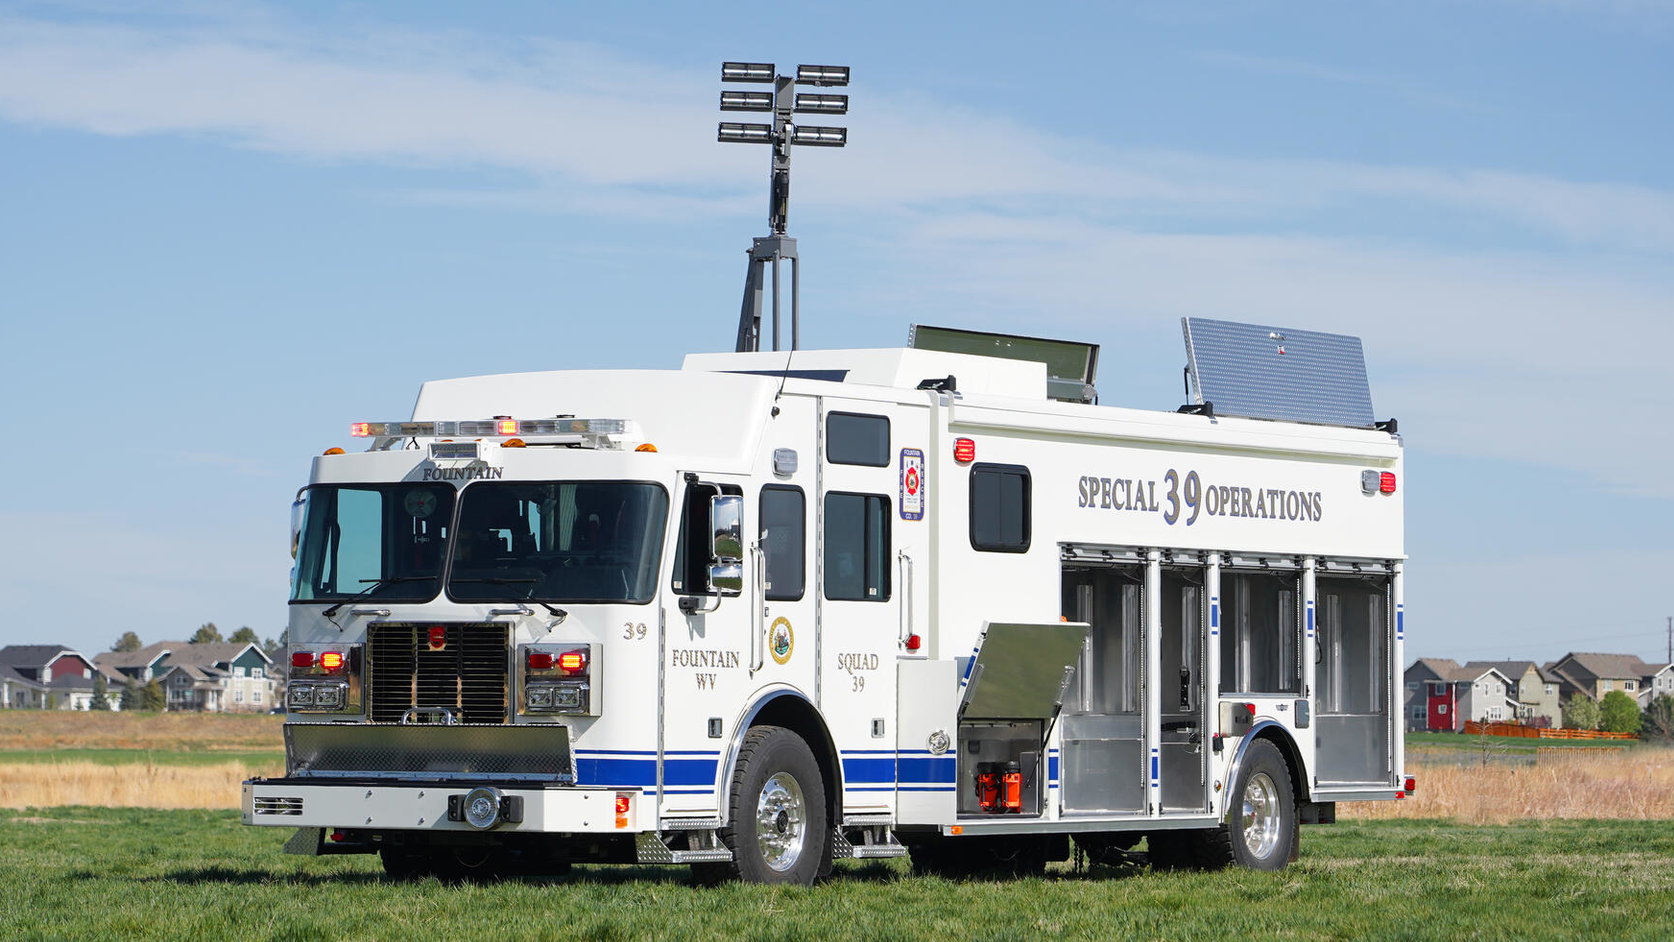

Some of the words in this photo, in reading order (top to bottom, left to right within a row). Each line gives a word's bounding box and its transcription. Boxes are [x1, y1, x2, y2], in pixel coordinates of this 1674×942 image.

[422, 466, 504, 481] FOUNTAIN
[1078, 475, 1160, 512] SPECIAL
[1163, 468, 1201, 527] 39
[1205, 484, 1322, 522] OPERATIONS
[623, 621, 647, 640] 39
[672, 649, 740, 668] FOUNTAIN
[838, 653, 879, 675] SQUAD
[696, 673, 717, 690] WV
[852, 676, 865, 692] 39
